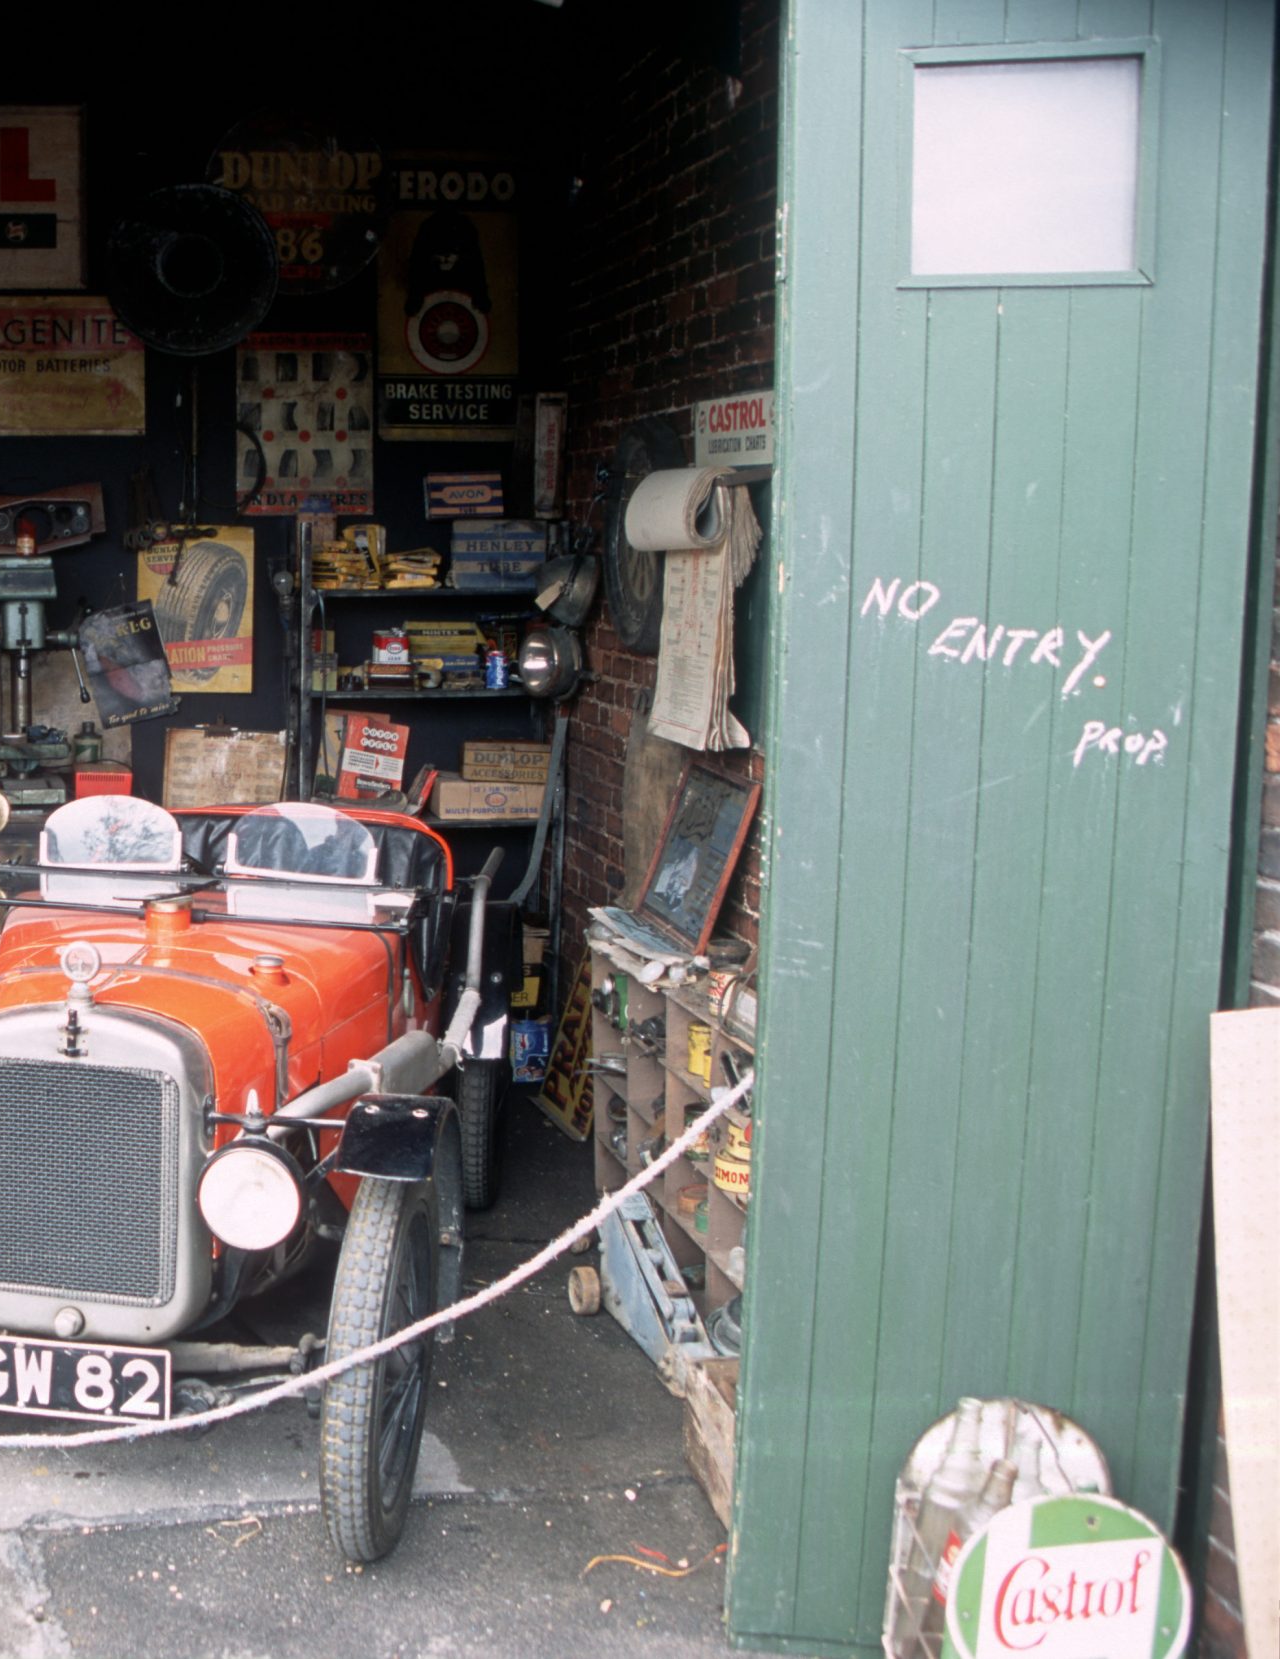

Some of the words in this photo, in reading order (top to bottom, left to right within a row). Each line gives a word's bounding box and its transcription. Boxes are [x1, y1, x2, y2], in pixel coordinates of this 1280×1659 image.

[220, 151, 383, 190] DUNLOP
[395, 170, 517, 202] ERODO
[37, 359, 111, 372] BATTERIES
[385, 383, 438, 399] BRAKE
[444, 382, 512, 399] TESTING
[408, 403, 489, 420] SERVICE
[708, 398, 766, 433] CASTROL
[745, 434, 766, 452] CHARTS
[449, 489, 485, 499] AVON
[467, 540, 536, 551] HENLEY
[861, 577, 940, 621] NO
[362, 726, 400, 741] MOTOR
[360, 737, 398, 752] CYCLE
[474, 751, 545, 766] DUNLOP
[471, 768, 545, 780] ACCESSORIES
[74, 1354, 161, 1416] 82
[993, 1549, 1152, 1652] Castrol
